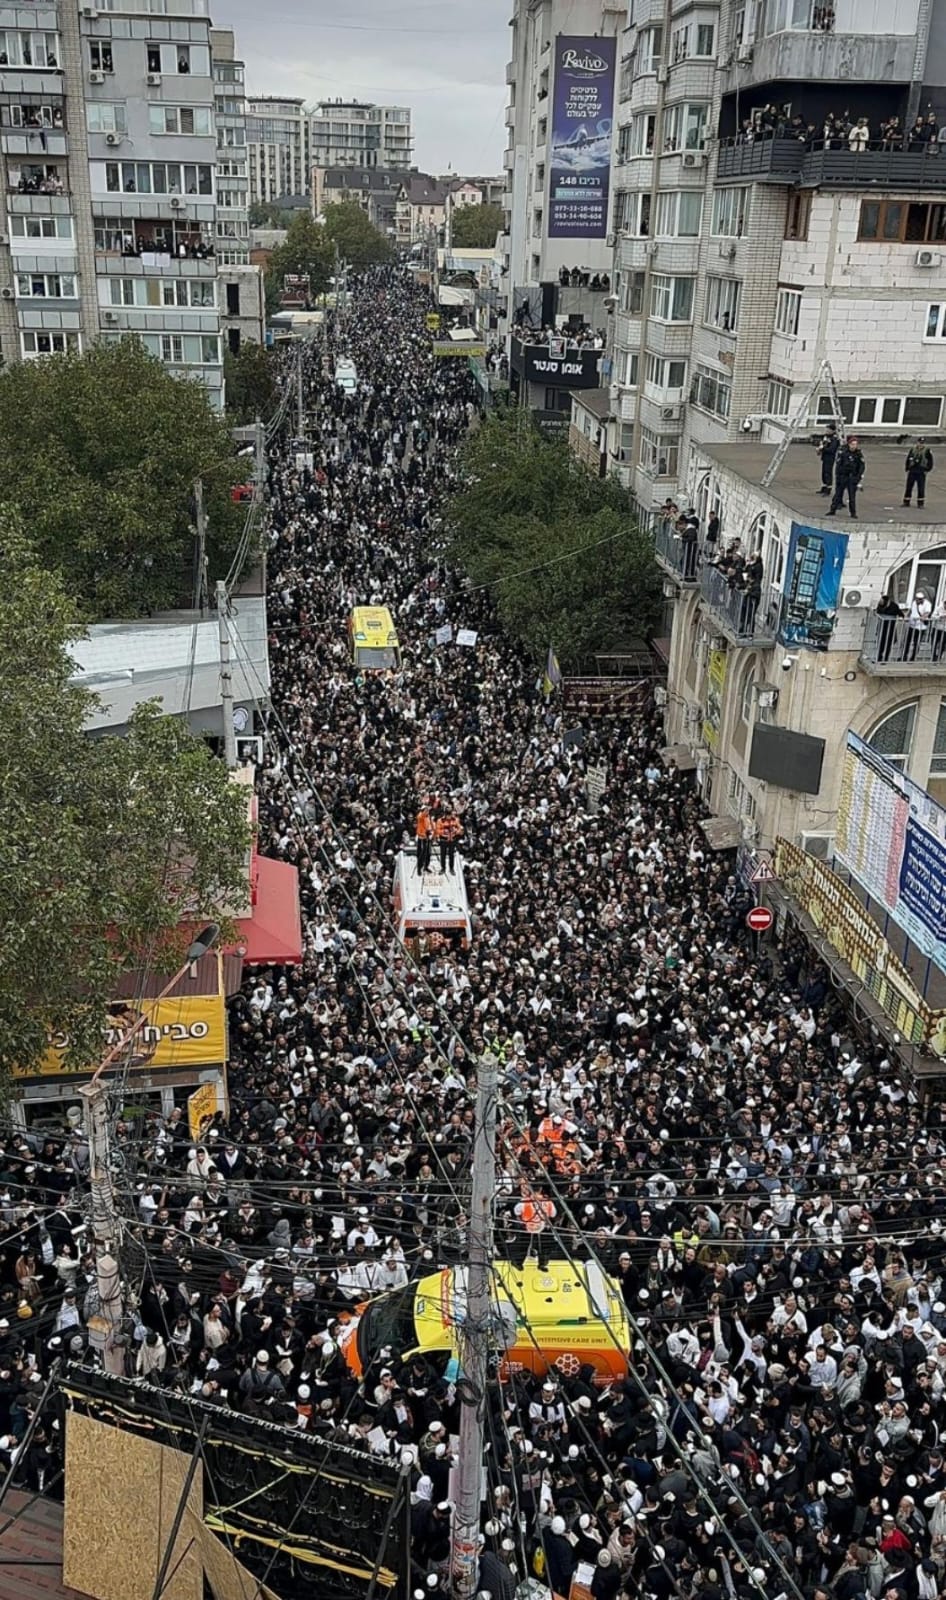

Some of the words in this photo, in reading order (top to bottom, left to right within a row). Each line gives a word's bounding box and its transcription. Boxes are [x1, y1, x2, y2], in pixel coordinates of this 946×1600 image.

[562, 49, 602, 69] Revivo
[560, 176, 577, 185] 148
[579, 177, 600, 185] רביבו
[533, 360, 559, 372] סנטר
[561, 363, 583, 375] אומן
[843, 900, 877, 950] המאפה
[143, 1022, 208, 1043] סביח
